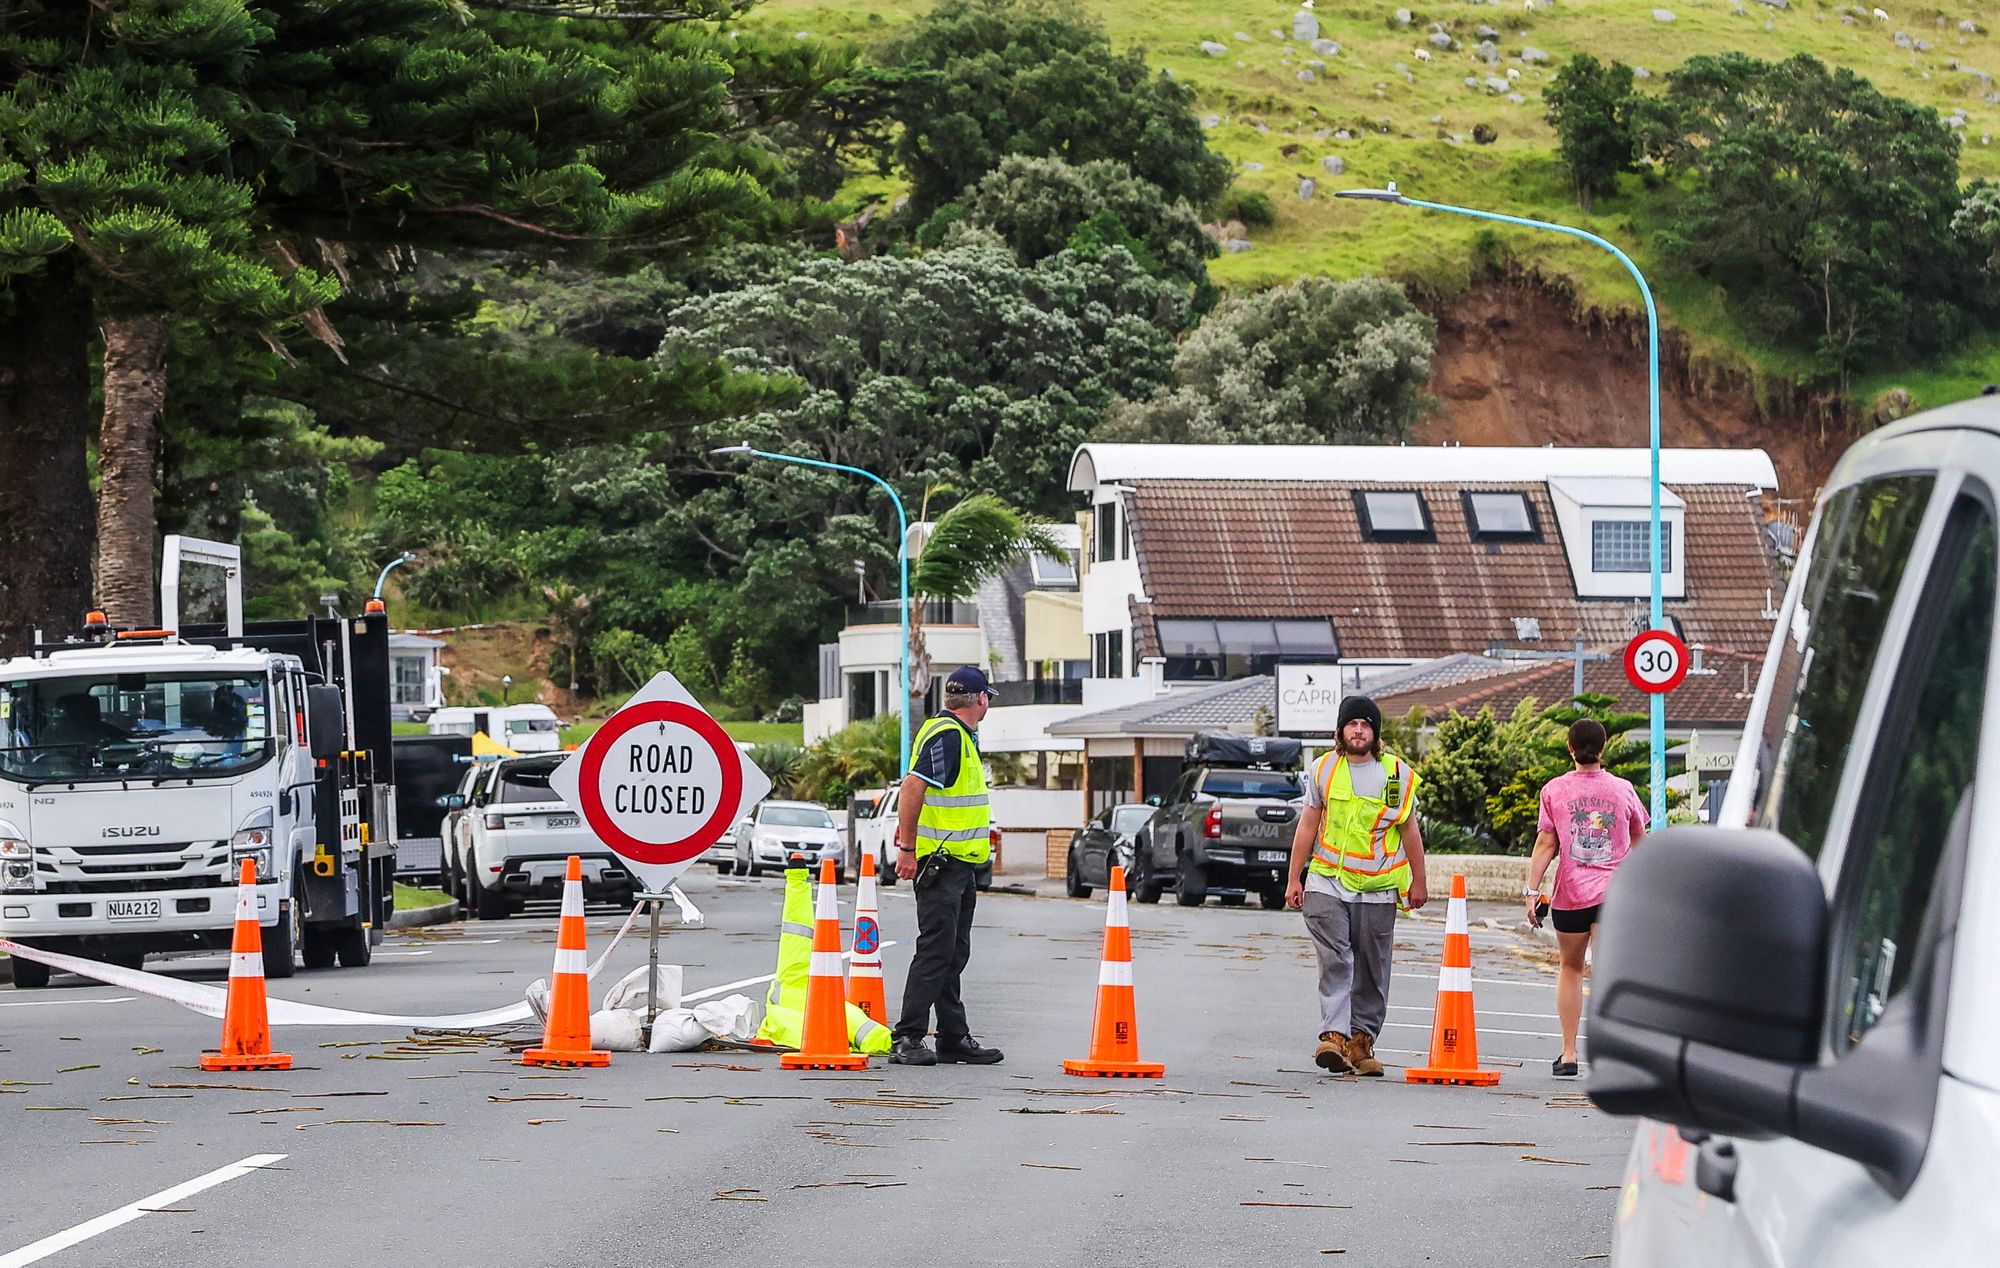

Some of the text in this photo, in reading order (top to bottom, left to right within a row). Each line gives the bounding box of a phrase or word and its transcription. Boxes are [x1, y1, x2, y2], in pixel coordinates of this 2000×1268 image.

[1640, 650, 1673, 673] 30
[1283, 689, 1336, 705] CAPRI
[629, 744, 693, 774] ROAD
[615, 784, 705, 815] CLOSED
[1567, 797, 1588, 811] STAY
[102, 826, 160, 838] ISUZU
[109, 901, 159, 916] NUA212
